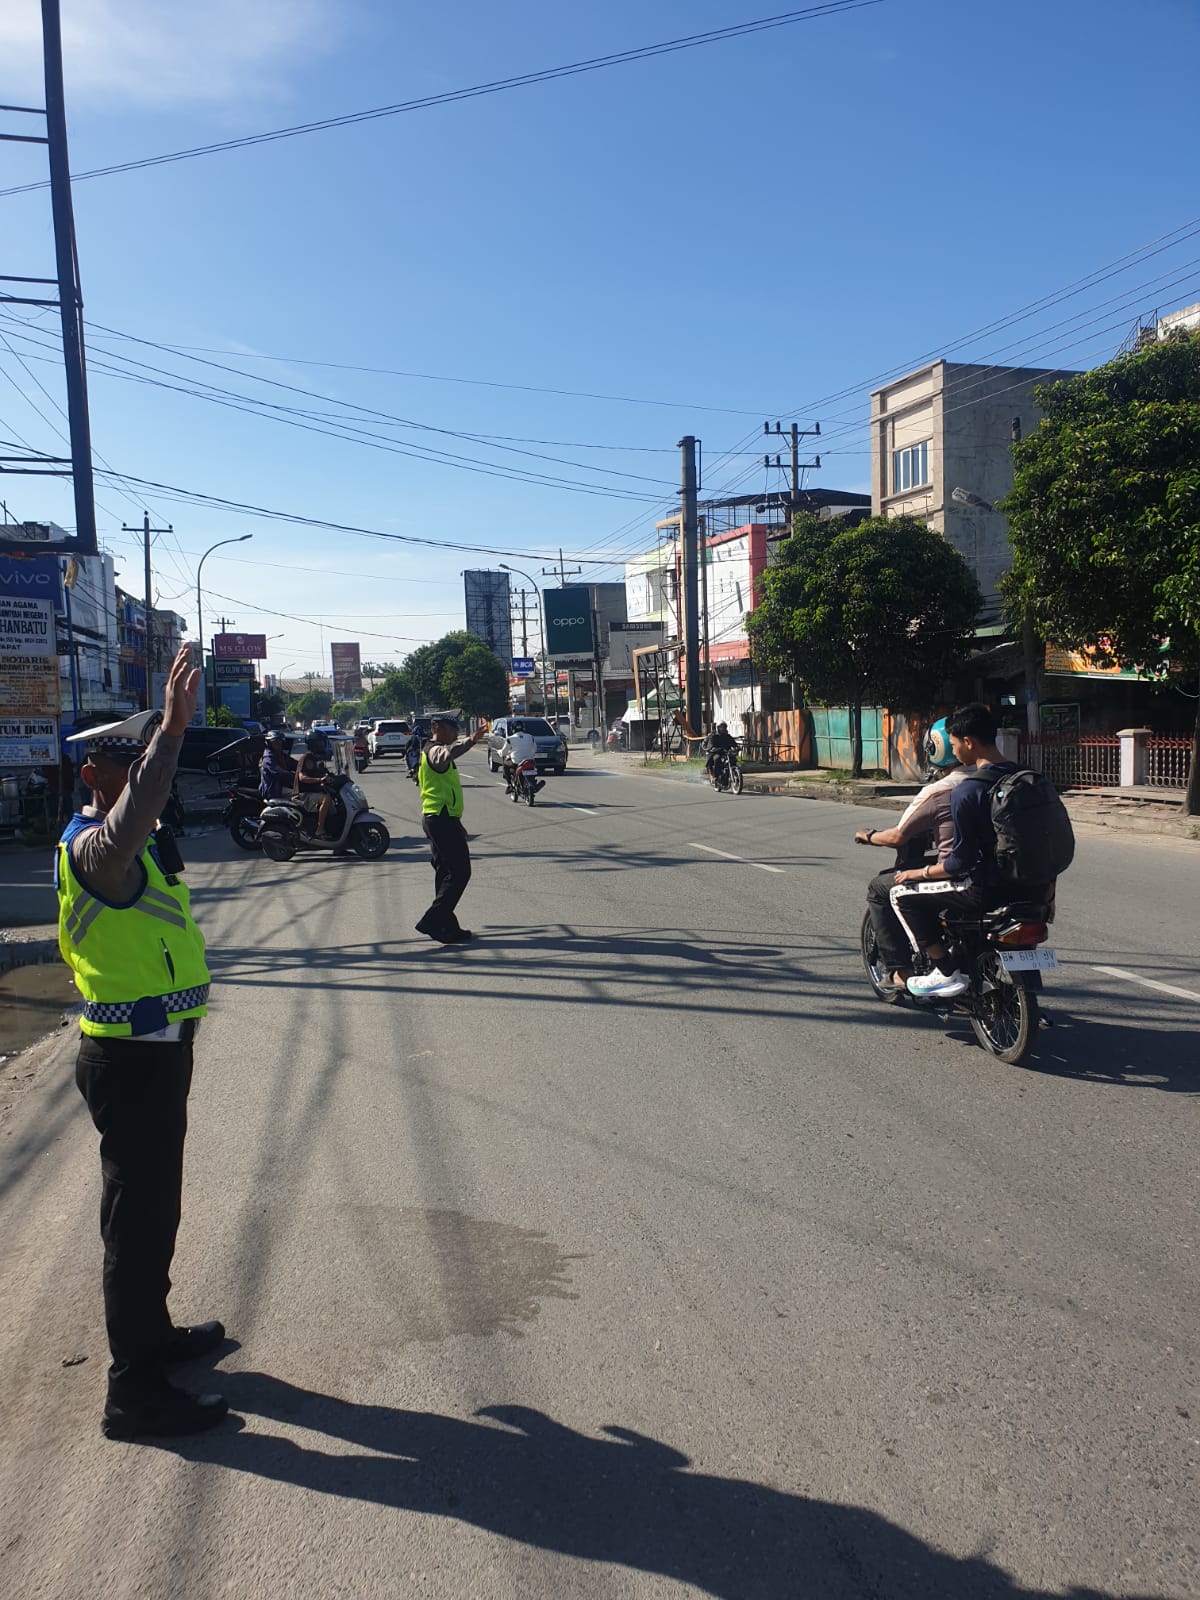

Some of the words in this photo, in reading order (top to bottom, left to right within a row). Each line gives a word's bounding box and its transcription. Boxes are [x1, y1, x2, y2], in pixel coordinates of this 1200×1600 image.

[0, 571, 50, 585] vivo
[13, 601, 38, 609] AGAMA
[553, 617, 585, 628] oppo
